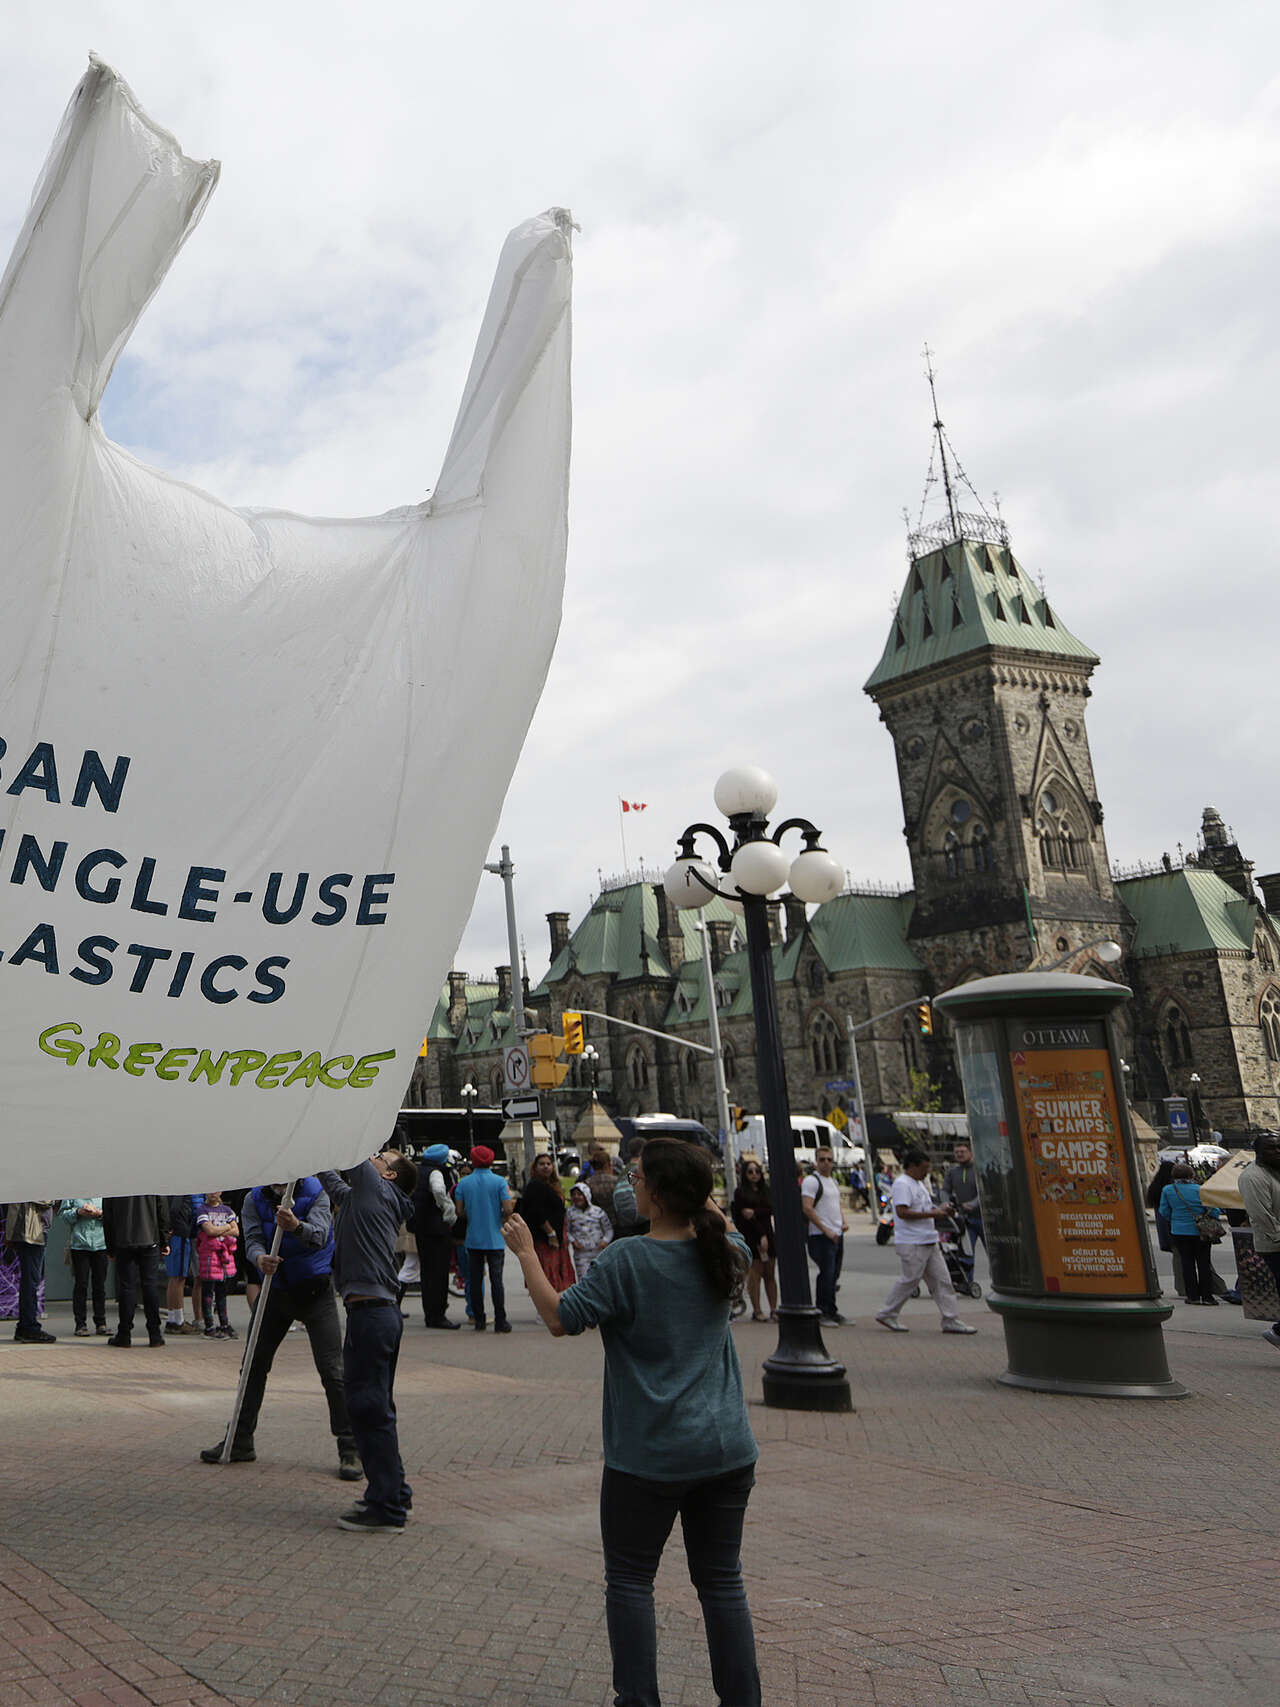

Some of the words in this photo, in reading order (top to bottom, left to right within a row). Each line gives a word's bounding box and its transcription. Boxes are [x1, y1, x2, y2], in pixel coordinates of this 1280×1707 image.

[1023, 1029, 1090, 1045] OTTAWA
[38, 1022, 396, 1090] GREENPEACE
[1034, 1100, 1103, 1118] SUMMER
[1053, 1118, 1105, 1133] CAMPS
[1041, 1141, 1108, 1159] CAMPS
[1066, 1159, 1108, 1175] JOUR
